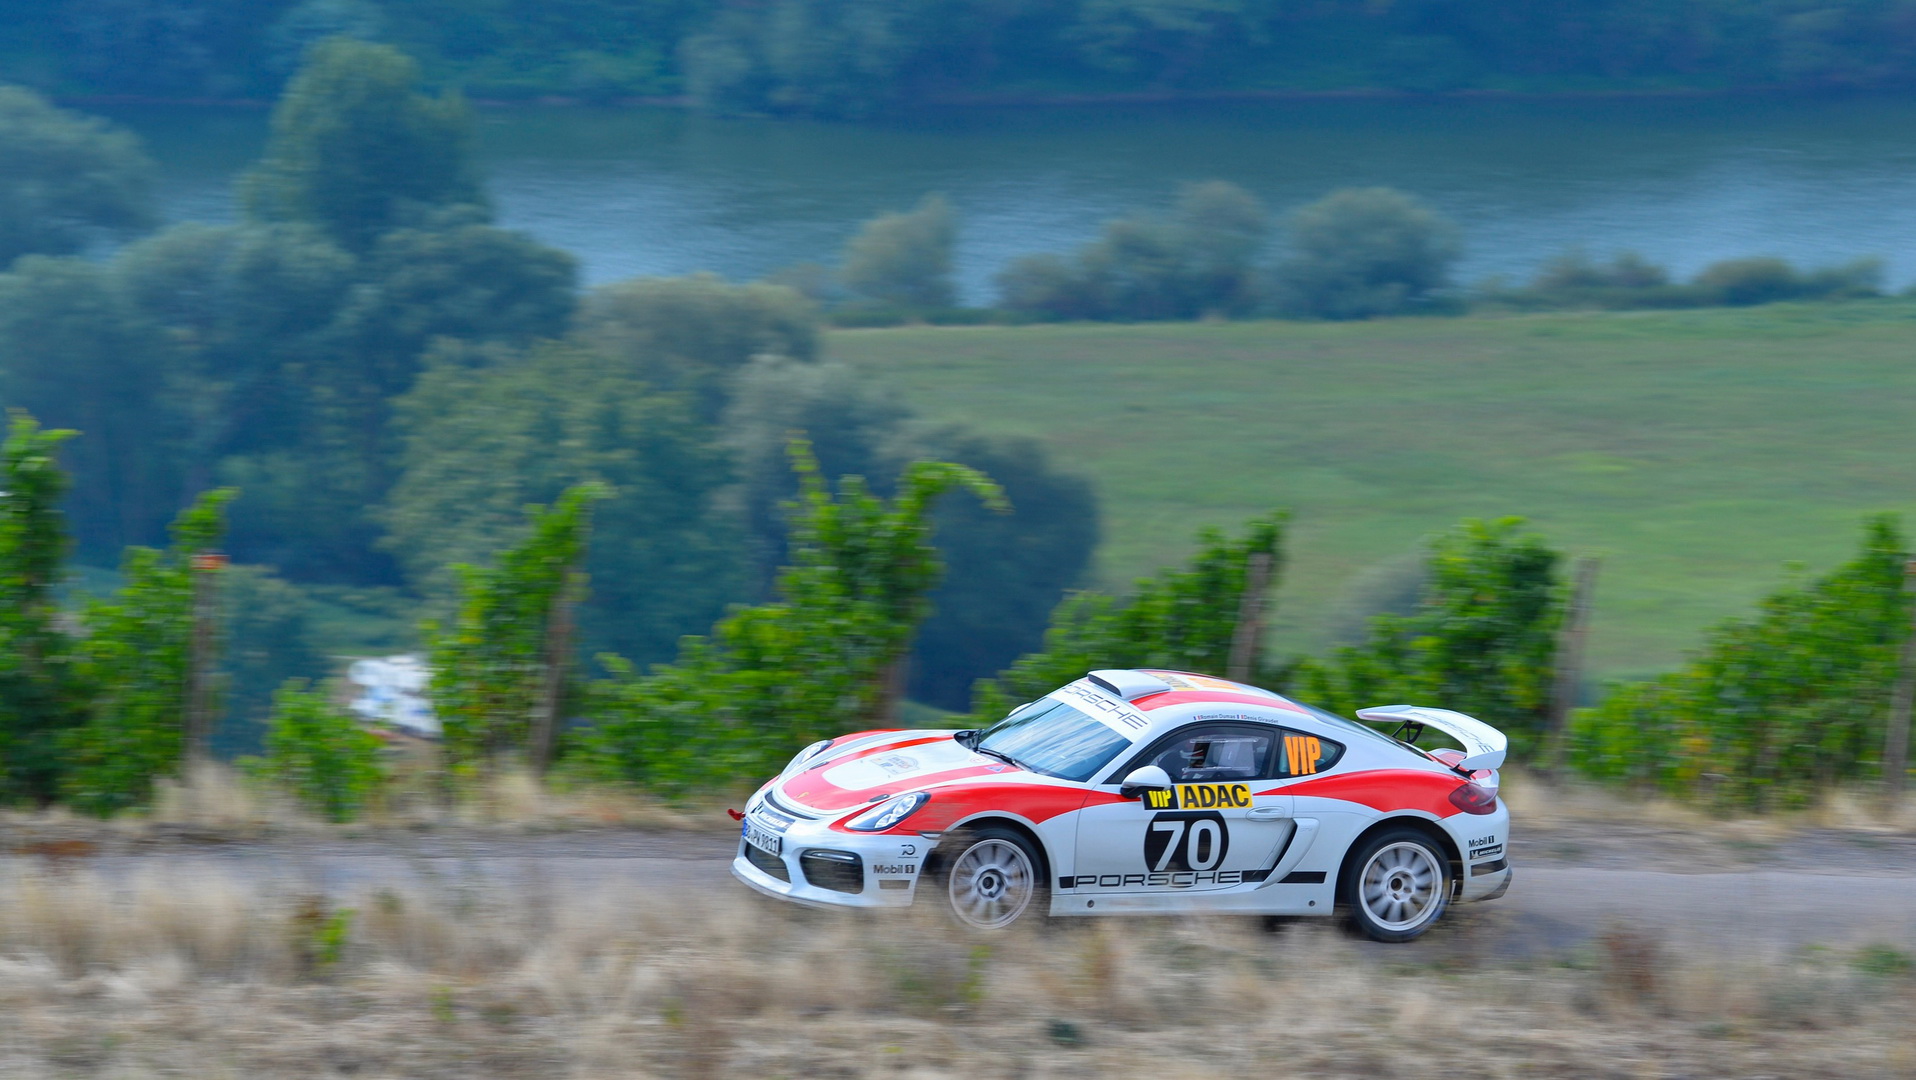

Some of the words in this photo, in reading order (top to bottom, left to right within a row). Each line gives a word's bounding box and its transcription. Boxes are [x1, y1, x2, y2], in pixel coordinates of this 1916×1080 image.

[1284, 736, 1321, 775] VIP
[1148, 789, 1172, 808] VIP
[1183, 784, 1249, 809] ADAC
[1152, 819, 1222, 872] 70
[1468, 836, 1488, 848] Mobil
[872, 864, 904, 874] Mobil
[1074, 870, 1241, 888] PORSCHE
